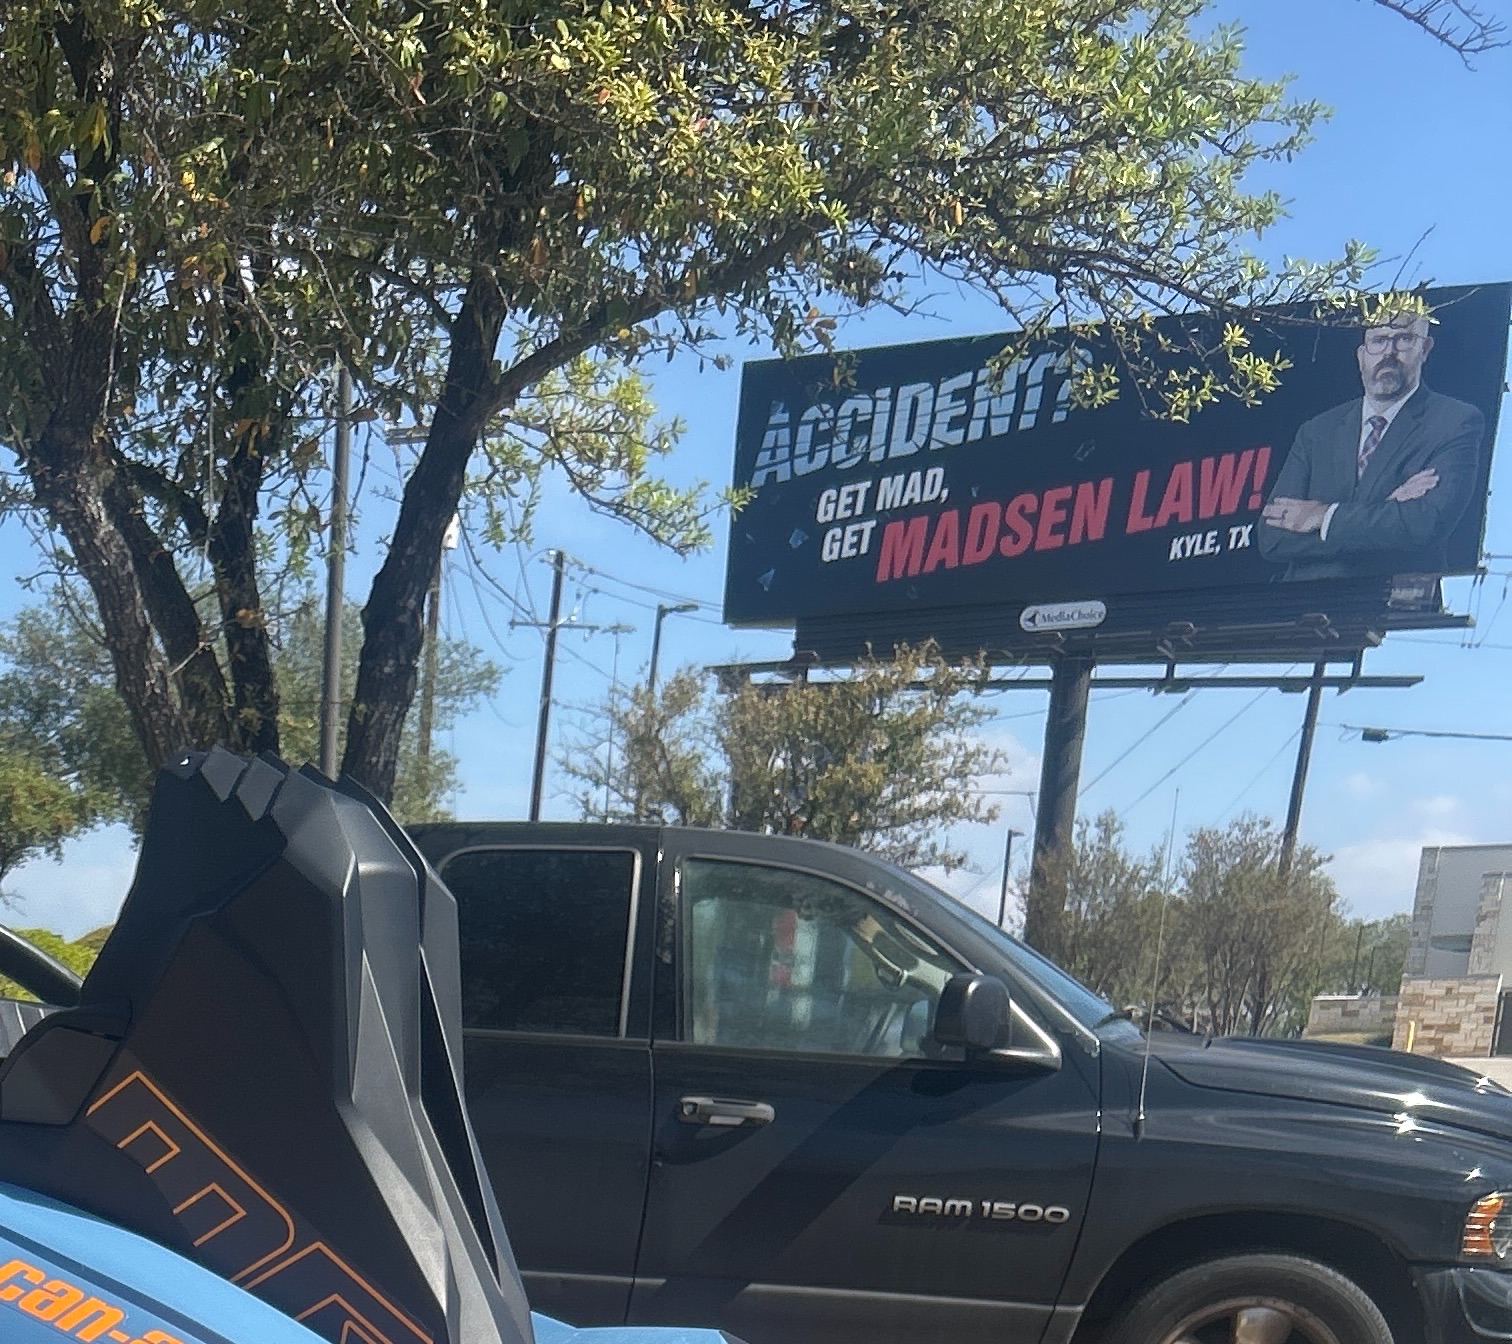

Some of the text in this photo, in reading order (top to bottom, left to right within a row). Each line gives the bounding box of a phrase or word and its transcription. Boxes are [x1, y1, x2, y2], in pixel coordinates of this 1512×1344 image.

[816, 467, 949, 524] GET MAD,
[821, 447, 1272, 583] GET MADSEN LAW!
[1168, 524, 1254, 562] KYLE, TX
[893, 1195, 1070, 1223] RAM 1500
